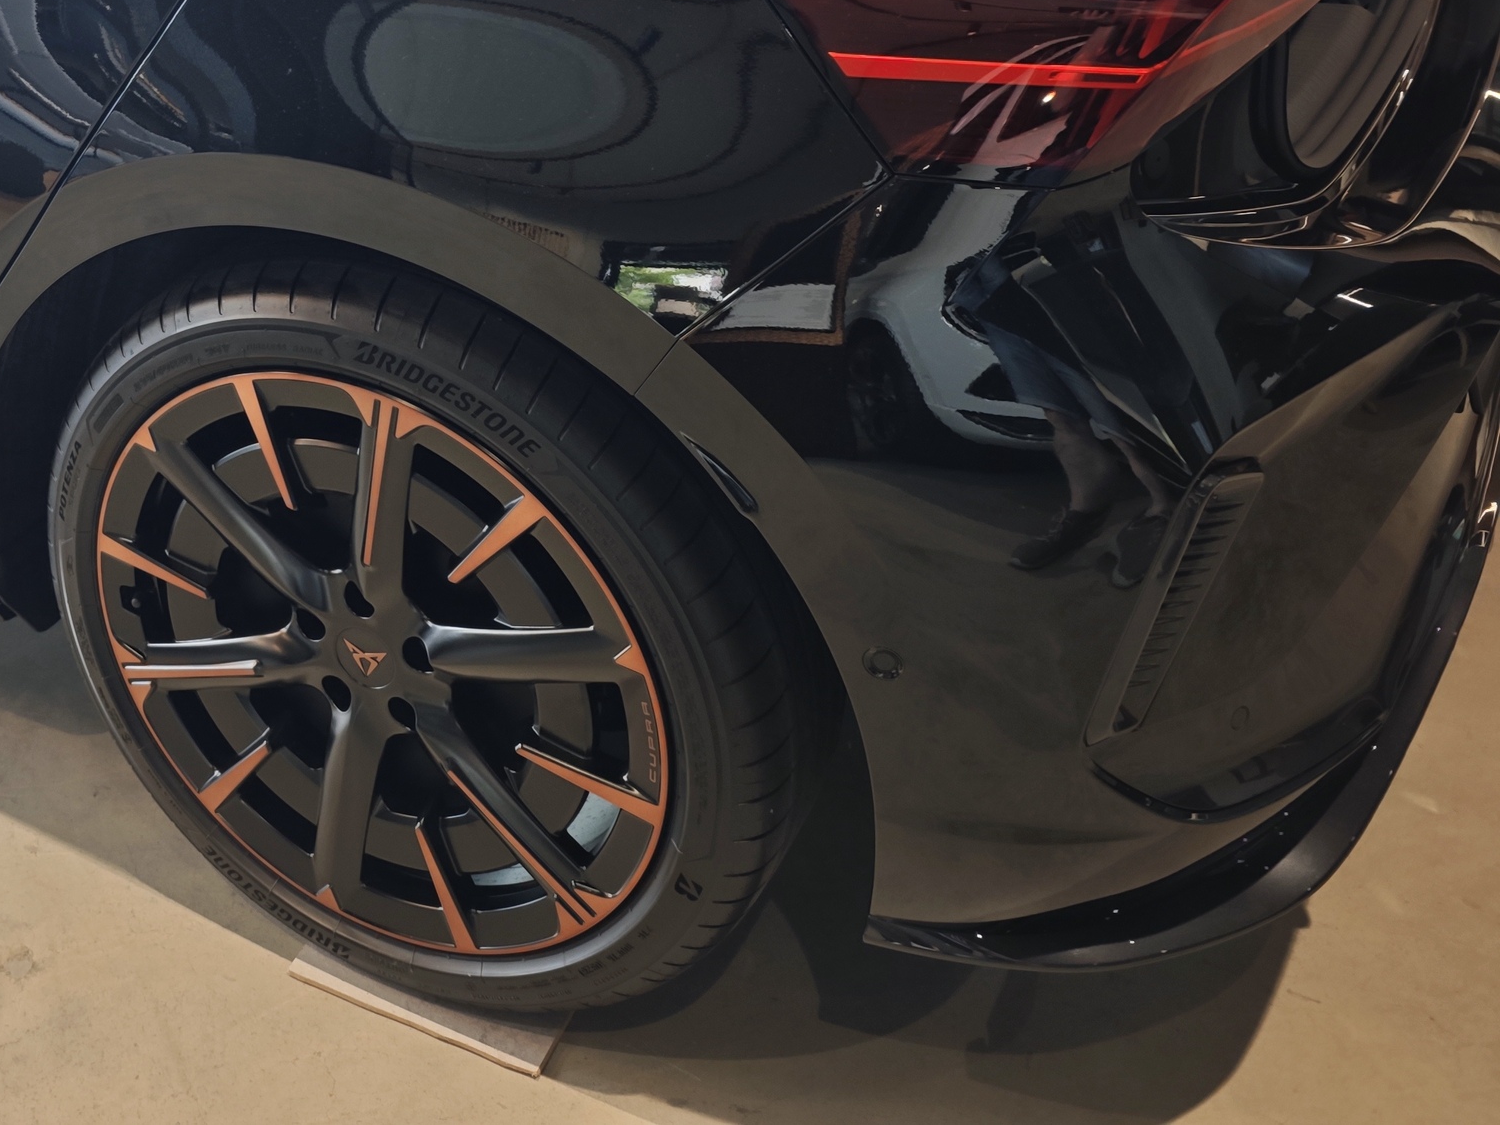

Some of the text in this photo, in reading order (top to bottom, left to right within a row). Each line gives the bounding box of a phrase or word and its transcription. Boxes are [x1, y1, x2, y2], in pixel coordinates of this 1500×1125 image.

[353, 341, 542, 459] BRIDGESTONE
[58, 440, 82, 522] POTENZA
[641, 701, 658, 784] CUPRA
[204, 845, 351, 960] BRIDGESTONE
